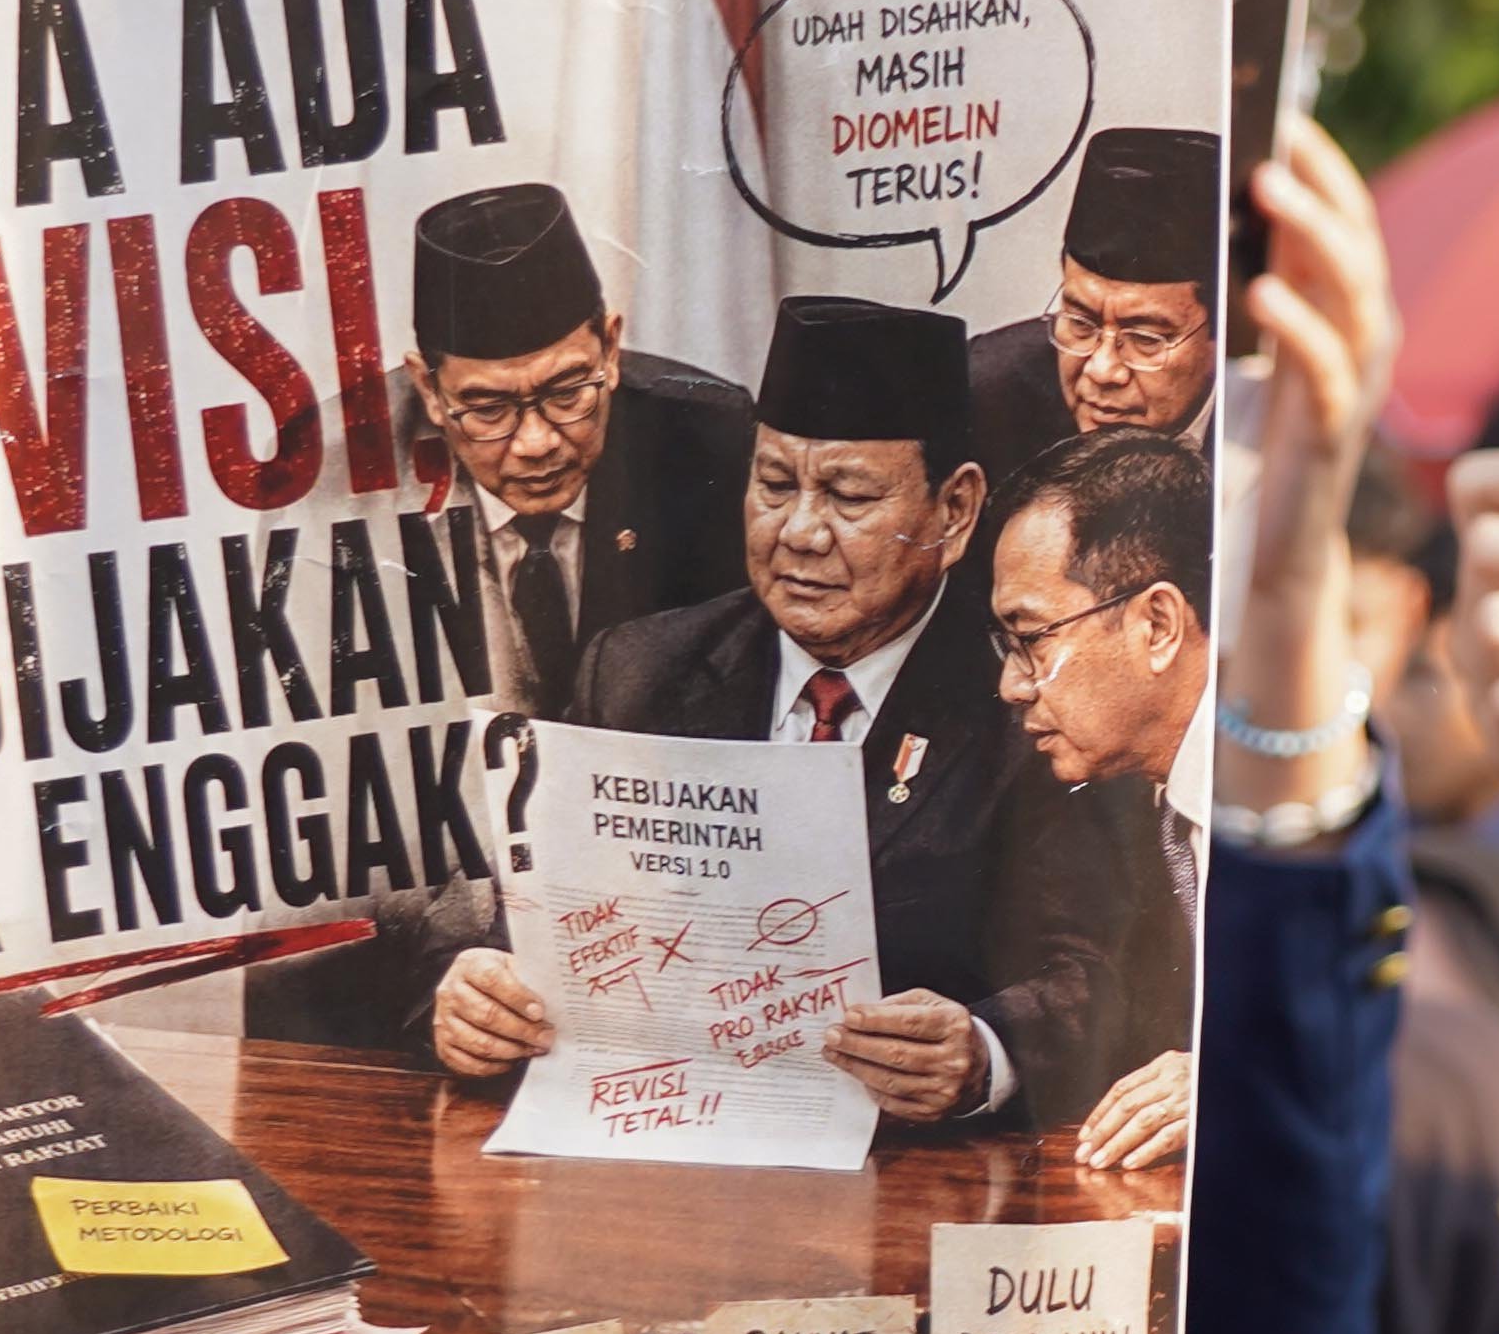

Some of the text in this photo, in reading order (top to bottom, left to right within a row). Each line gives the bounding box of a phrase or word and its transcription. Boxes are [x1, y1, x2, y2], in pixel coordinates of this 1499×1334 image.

[793, 9, 864, 46] UDAH
[857, 47, 965, 96] MASIH
[833, 100, 1000, 155] DIOMELIN
[846, 152, 983, 209] TERUS!
[591, 774, 759, 815] KEBIJAKAN
[32, 712, 541, 945] ENGGAK?
[594, 814, 763, 851] PEMERINTAH
[629, 851, 731, 880] VERSI 1.0
[558, 897, 625, 941] TIDAK
[568, 924, 642, 974] EFEKTIF
[708, 964, 785, 1011] TIDAK
[709, 1016, 754, 1050] PRO
[762, 975, 849, 1031] RAKYAT
[590, 1071, 688, 1114] REVISI
[1, 1133, 108, 1168] RAKYAT
[69, 1196, 198, 1219] PERBAIKI
[77, 1223, 243, 1246] METODOLOGI
[984, 1266, 1094, 1316] DULU
